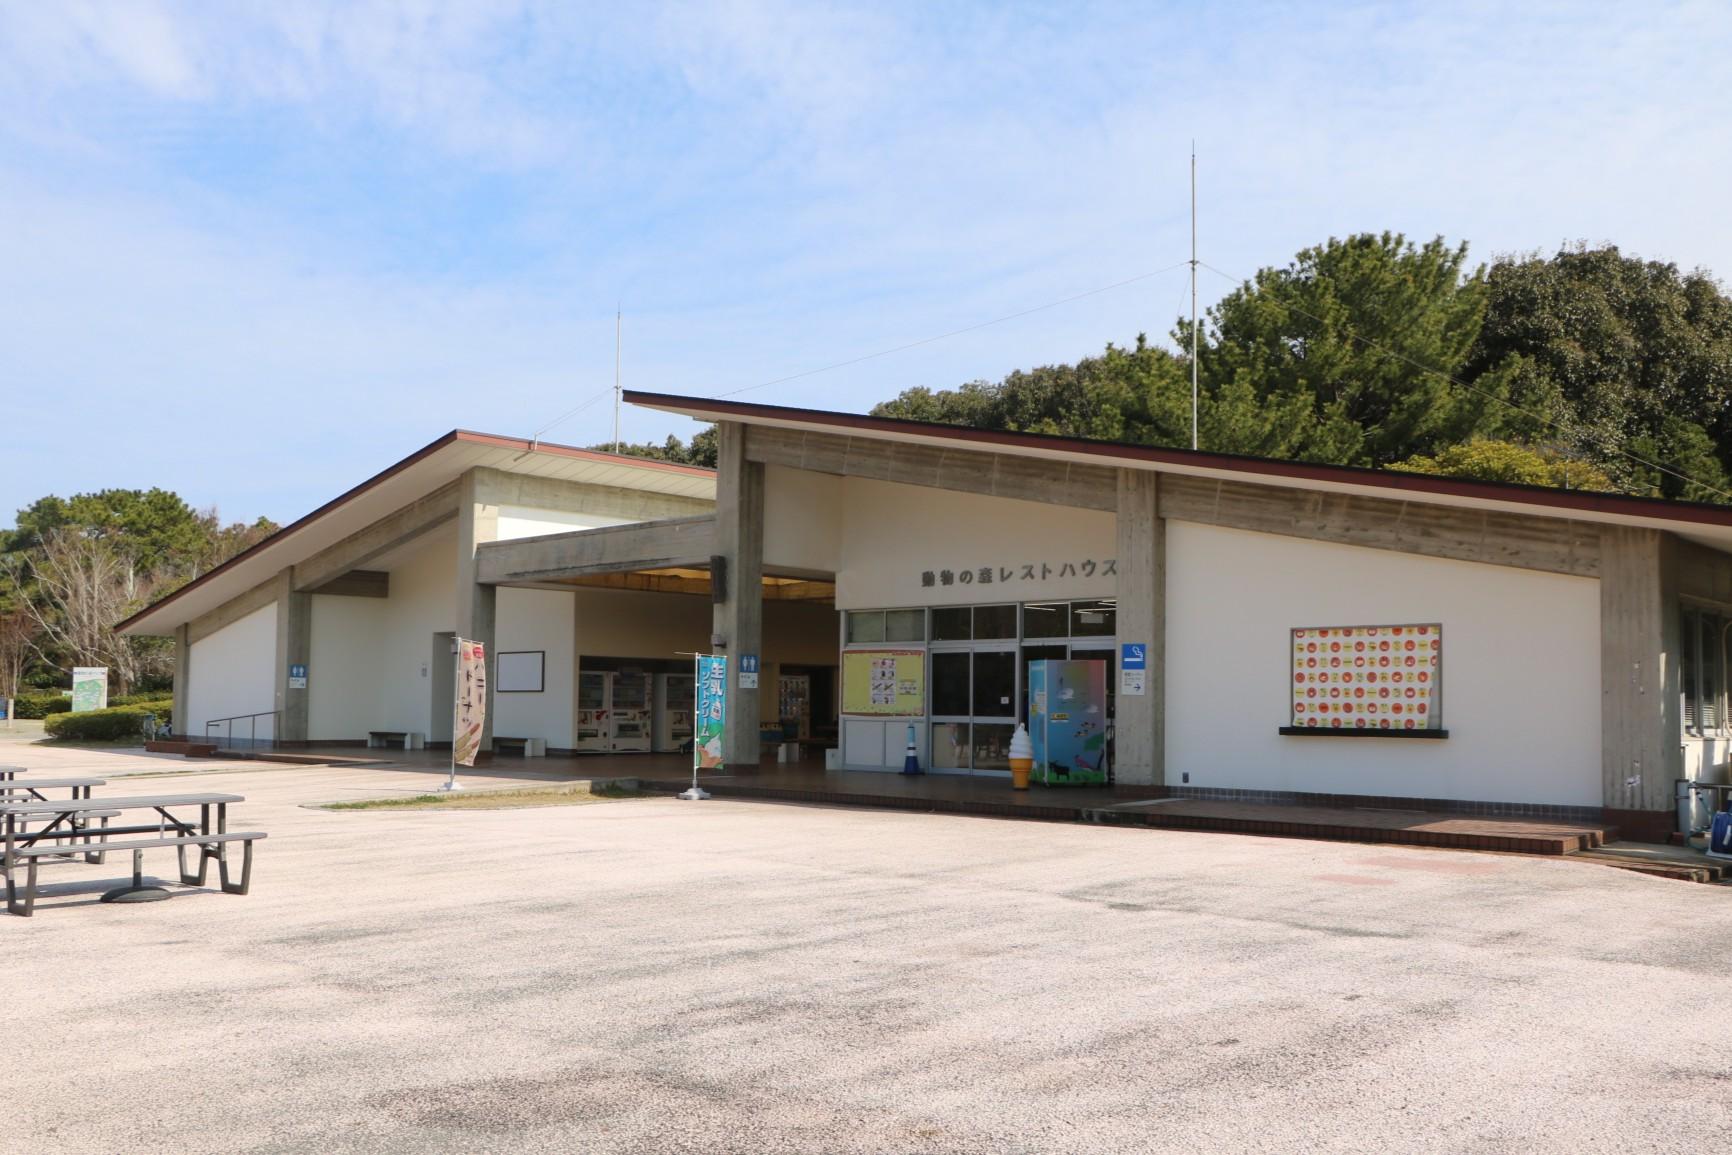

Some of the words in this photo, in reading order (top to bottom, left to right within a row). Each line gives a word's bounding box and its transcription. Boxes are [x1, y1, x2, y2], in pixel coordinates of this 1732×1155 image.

[700, 670, 711, 737] ソフトクリーム
[711, 662, 725, 697] 生乳
